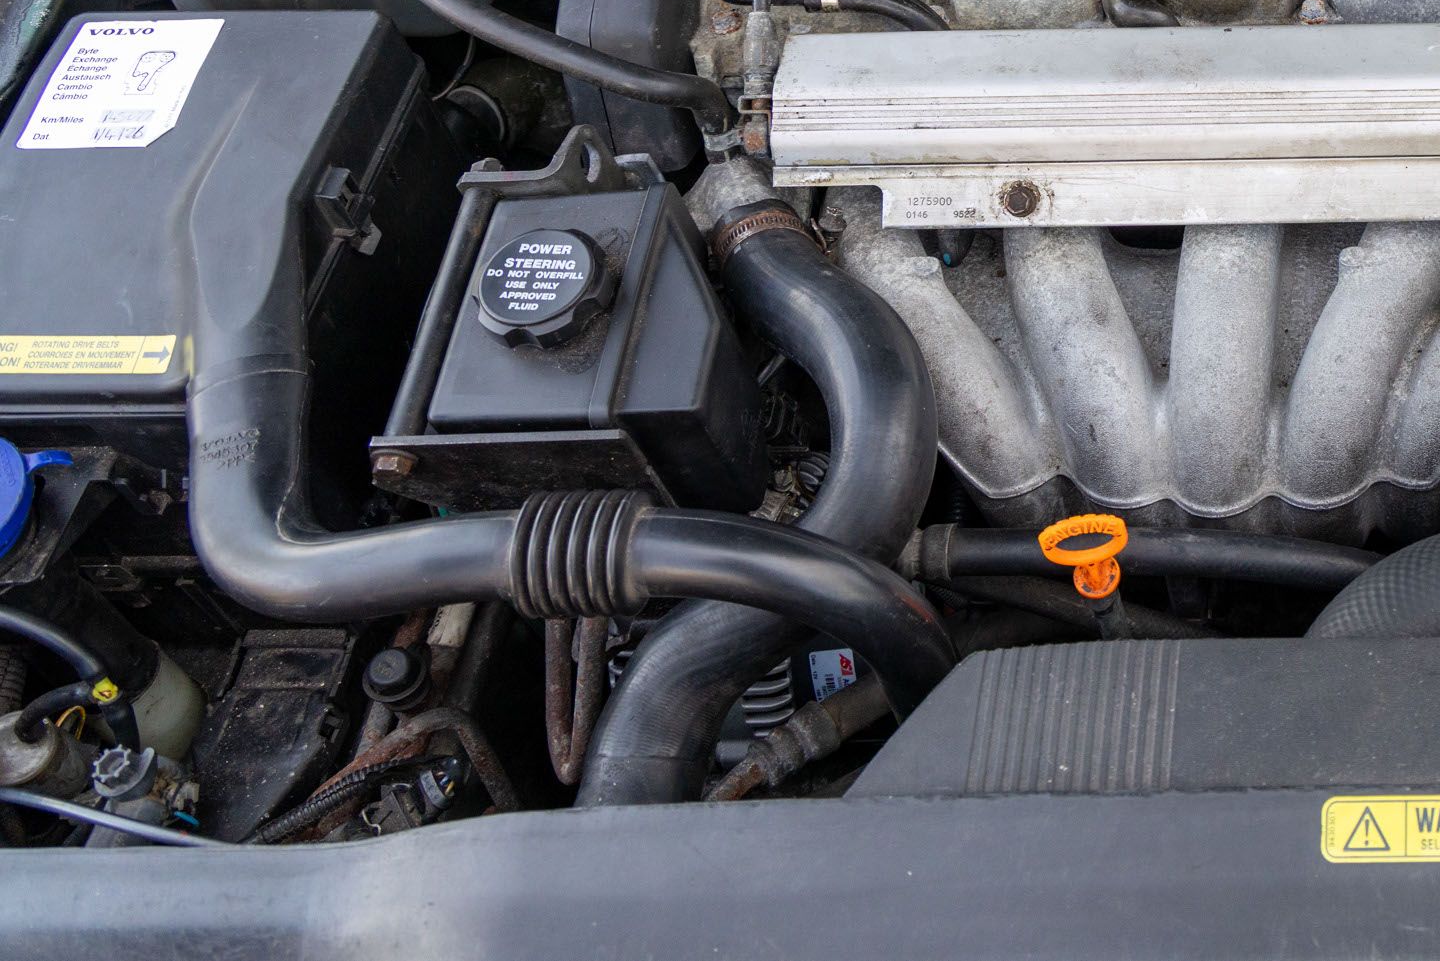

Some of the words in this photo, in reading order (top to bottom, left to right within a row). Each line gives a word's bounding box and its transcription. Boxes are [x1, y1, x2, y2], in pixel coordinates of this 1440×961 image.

[89, 27, 155, 36] VOLVO
[77, 48, 99, 56] Byte
[72, 56, 118, 64] Exchange
[61, 73, 112, 82] Austausch
[57, 83, 93, 91] Cambio
[40, 116, 84, 124] Km/Miles
[32, 133, 49, 141] Dat
[908, 197, 953, 206] 1275900
[906, 210, 928, 219] 0146
[953, 210, 976, 218] 9522
[518, 243, 573, 255] POWER
[504, 257, 576, 270] STEERING
[487, 269, 504, 277] DO
[507, 270, 530, 278] NOT
[535, 271, 584, 280] OVERFILL
[505, 281, 527, 289] USE
[532, 282, 560, 290] ONLY
[499, 291, 557, 300] APPROVED
[508, 302, 539, 311] FLUID
[0, 342, 17, 352] NG!
[72, 341, 94, 349] DRIVE
[96, 341, 120, 349] BELTS
[28, 351, 74, 359] COURROIES
[87, 351, 137, 359] MOUVEMENT
[0, 357, 20, 367] ON!
[23, 361, 70, 369] ROTERANDE
[71, 361, 124, 369] DRIVREMMAR
[1046, 520, 1116, 547] ENGINE
